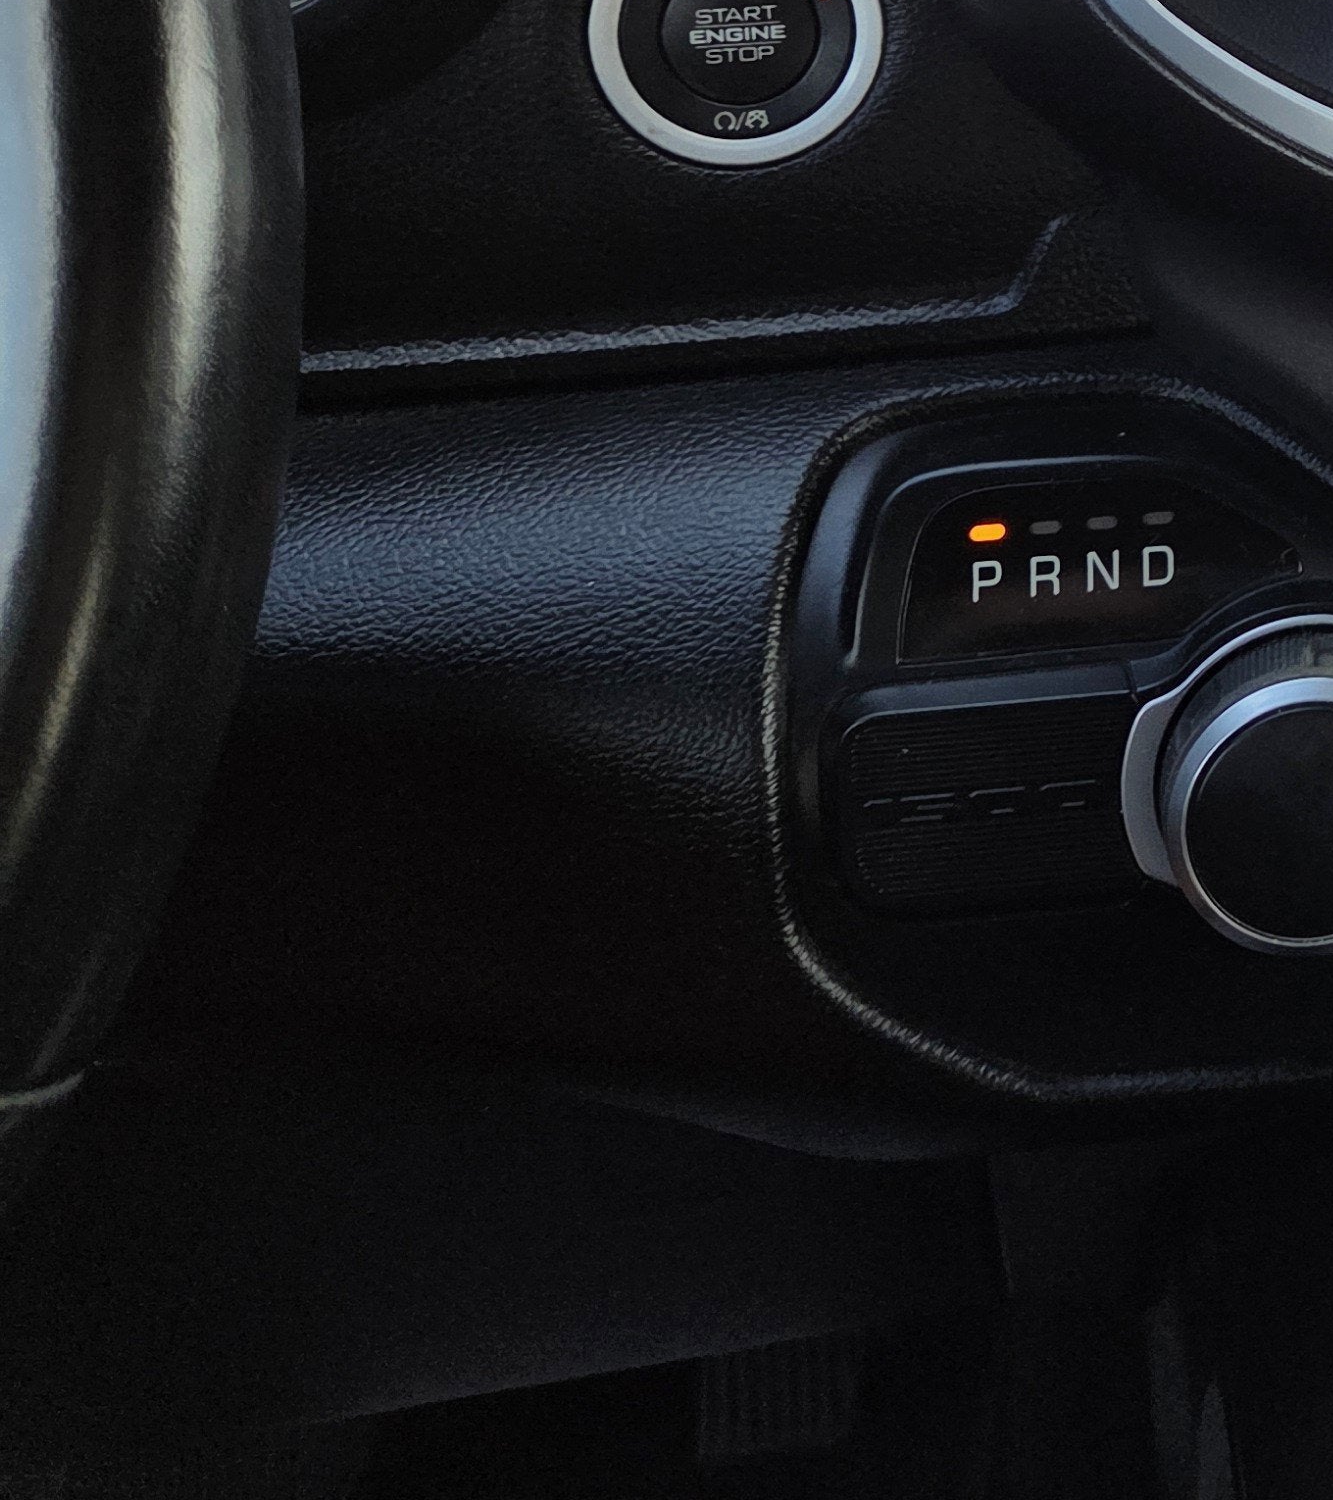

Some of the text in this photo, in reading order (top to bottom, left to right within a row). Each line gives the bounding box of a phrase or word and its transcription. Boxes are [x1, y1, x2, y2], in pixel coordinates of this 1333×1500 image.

[695, 4, 777, 25] START
[689, 24, 786, 45] ENGINE
[705, 45, 775, 65] STOP
[971, 545, 1175, 602] P R N D
